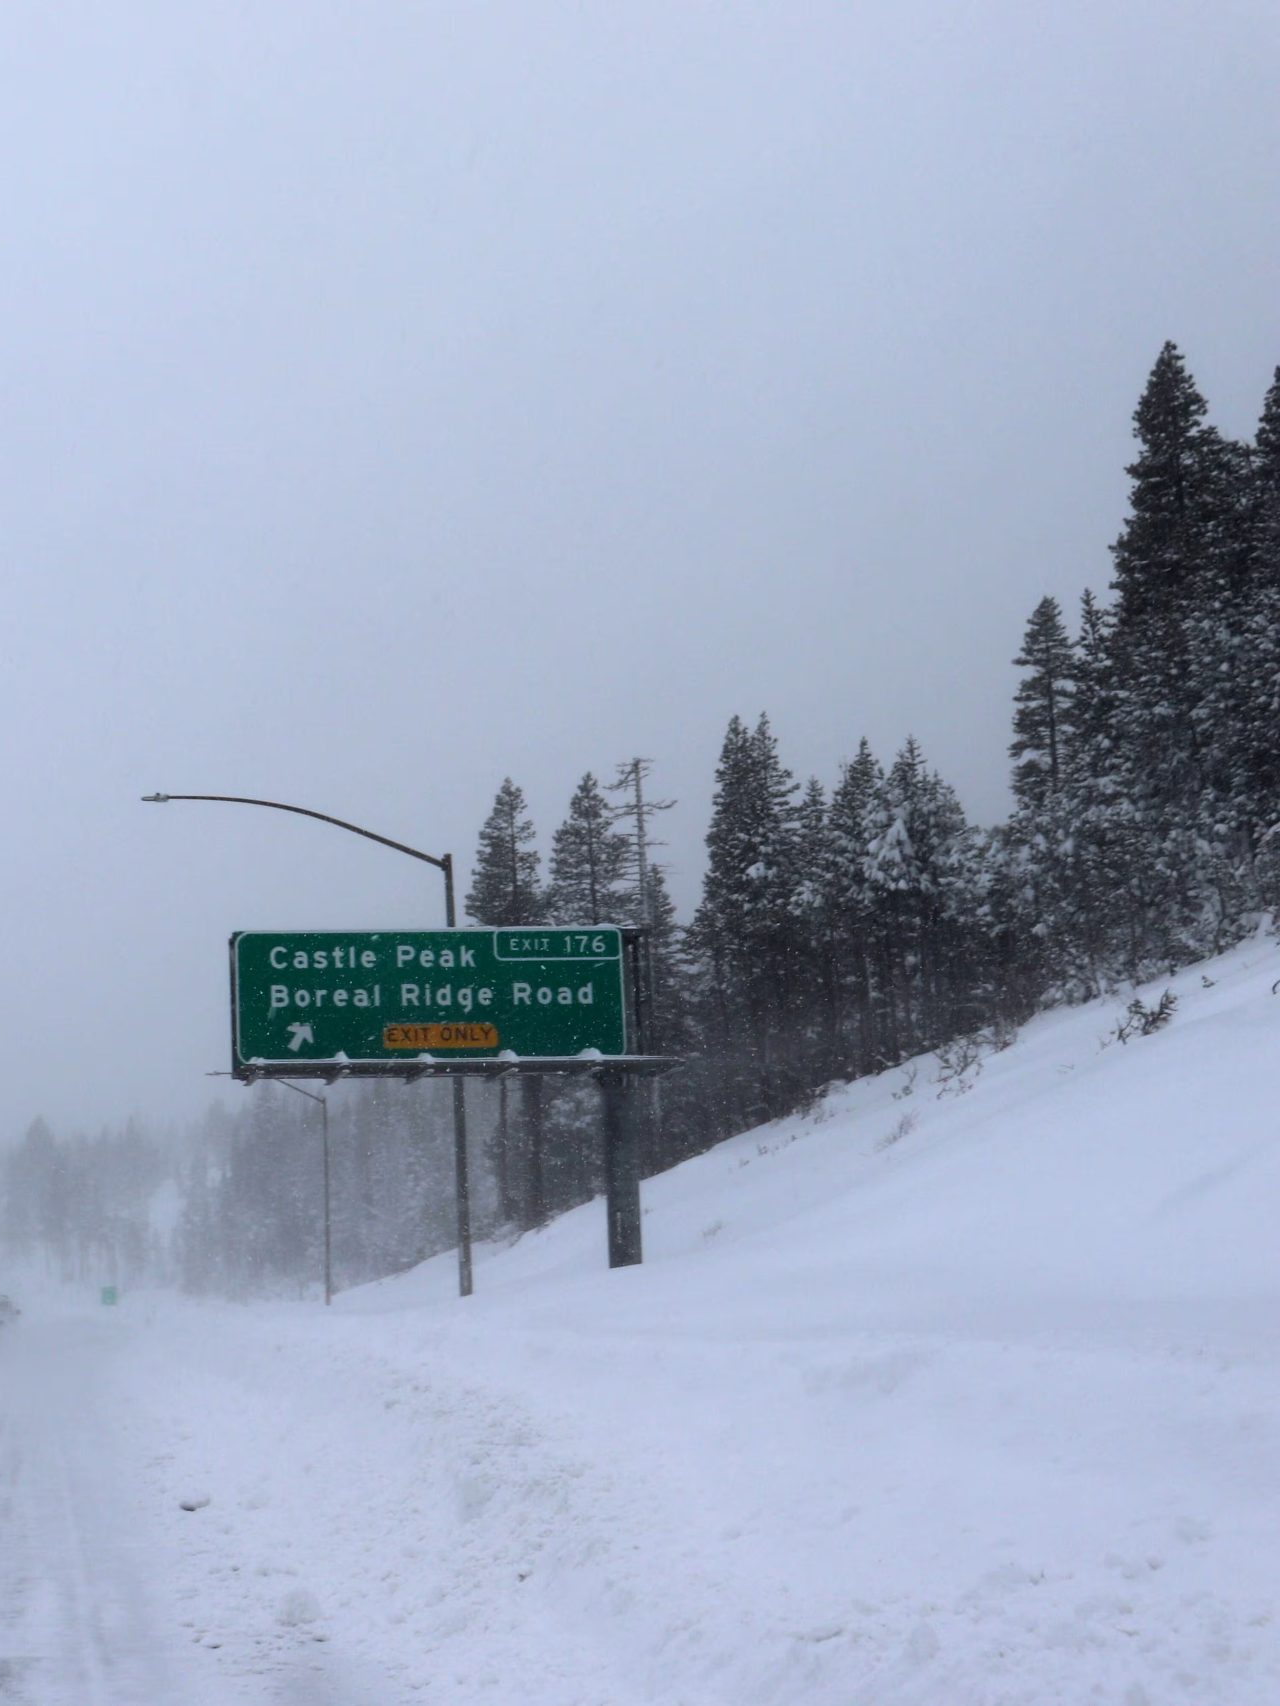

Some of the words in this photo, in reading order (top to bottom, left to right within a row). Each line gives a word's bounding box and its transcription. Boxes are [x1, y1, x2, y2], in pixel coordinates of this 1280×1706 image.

[509, 939, 550, 951] EXIT
[563, 935, 607, 953] 176
[269, 945, 377, 969] Castle
[396, 944, 477, 968] Peak
[269, 984, 382, 1008] Boreal
[401, 982, 494, 1013] Ridge
[512, 981, 595, 1005] Road
[386, 1027, 433, 1042] EXIT
[439, 1026, 493, 1042] ONLY
